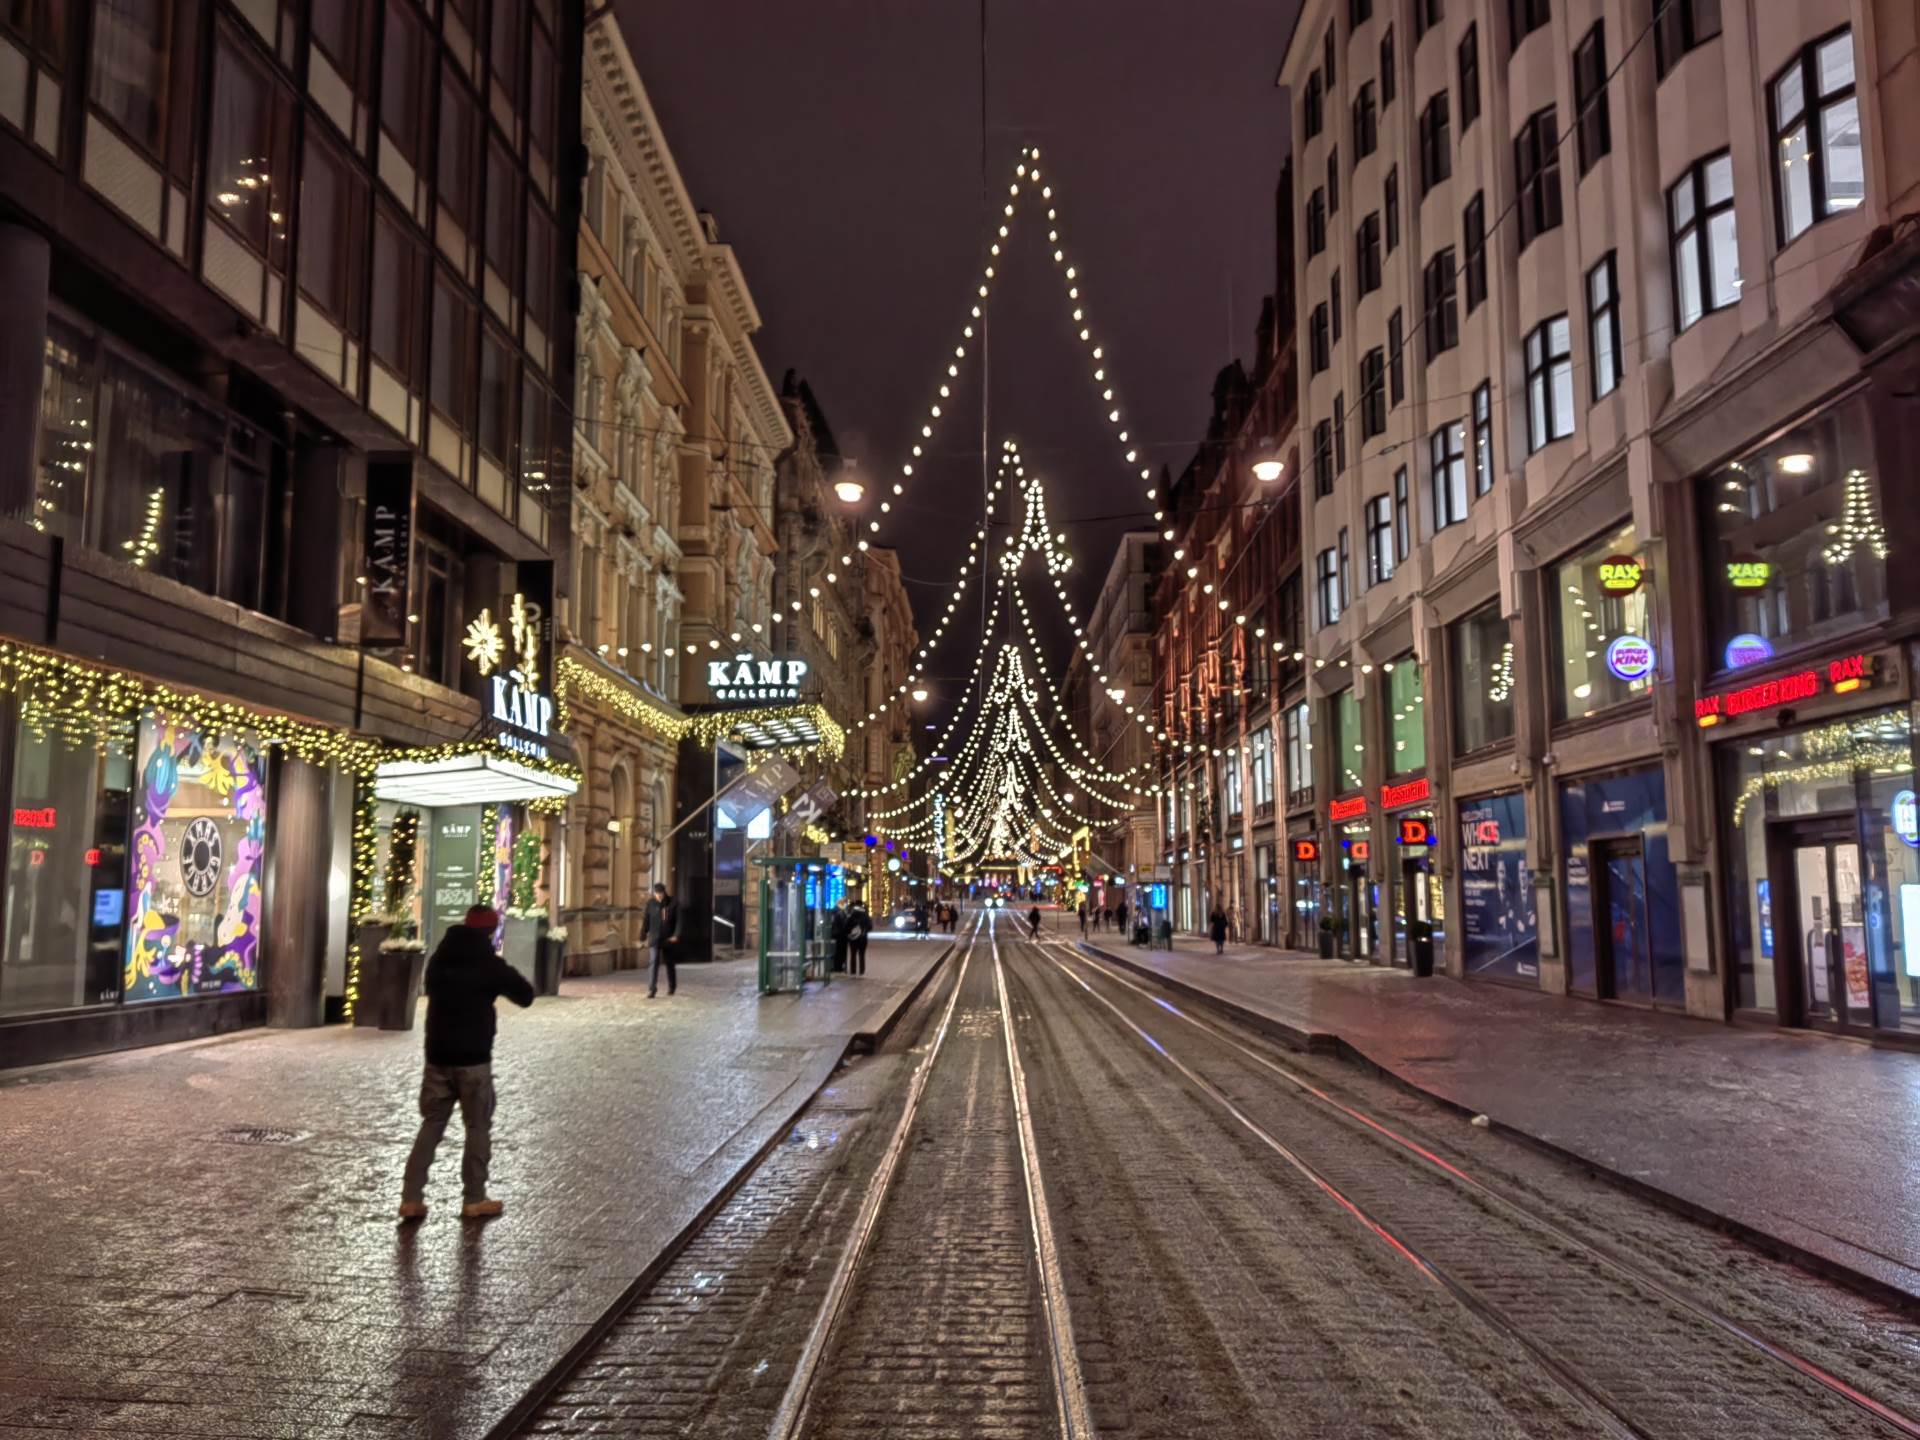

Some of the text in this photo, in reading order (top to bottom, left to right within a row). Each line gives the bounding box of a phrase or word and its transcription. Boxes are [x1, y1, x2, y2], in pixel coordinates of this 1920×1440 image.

[1600, 564, 1640, 580] RAX
[1615, 648, 1648, 656] BURGER
[1615, 655, 1648, 665] KING
[1829, 656, 1863, 682] RAX
[716, 688, 797, 699] GALLERIA
[1726, 672, 1817, 717] BURGER KING
[1695, 696, 1720, 718] RAX
[1403, 821, 1426, 843] D
[1297, 842, 1315, 859] D
[1463, 847, 1490, 872] NEXT
